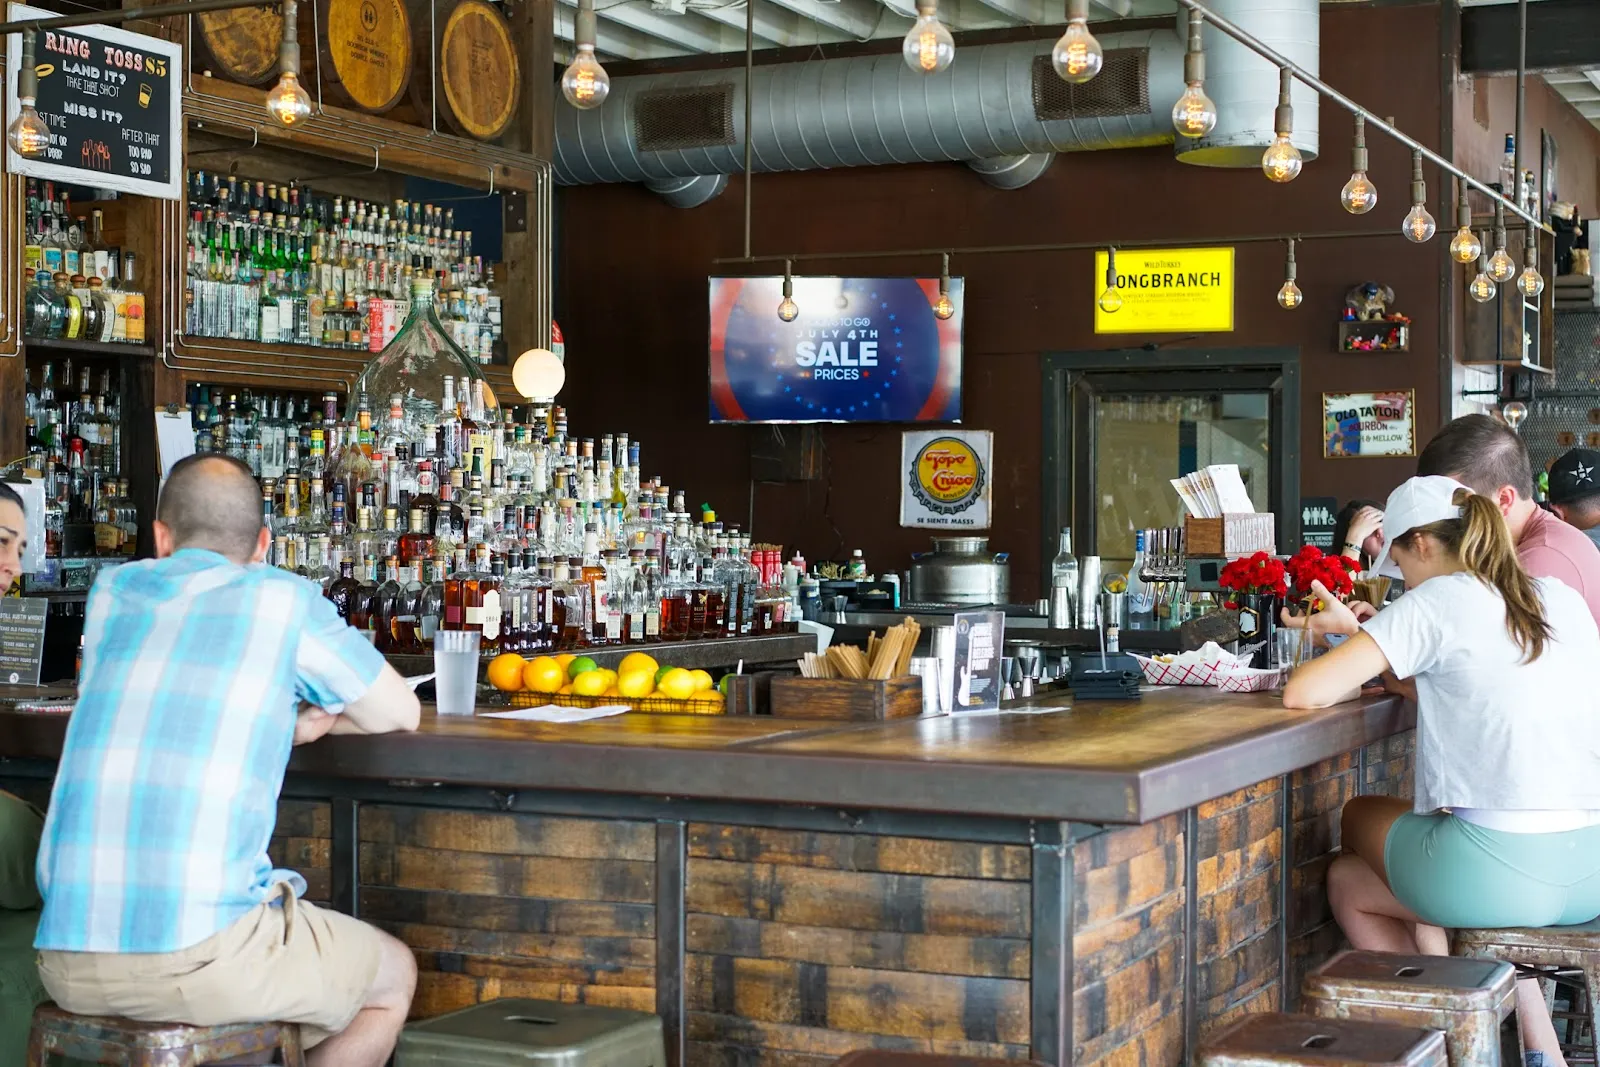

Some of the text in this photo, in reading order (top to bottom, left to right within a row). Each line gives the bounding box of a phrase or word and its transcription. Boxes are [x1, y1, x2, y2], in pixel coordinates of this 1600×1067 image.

[45, 31, 167, 77] RING TOSS $5
[62, 59, 127, 85] LAND IT?
[66, 75, 120, 98] TAKE THAT SHOT
[39, 111, 67, 129] ST TIME
[63, 101, 123, 124] MISS IT?
[59, 135, 68, 147] OR
[121, 128, 161, 147] AFTER THAT
[128, 145, 153, 160] TOO BAD
[130, 161, 152, 175] SO SAD
[1116, 272, 1221, 289] ONGBRANCH
[853, 317, 871, 327] GO
[795, 329, 878, 340] JULY 4TH
[795, 341, 878, 367] SALE
[814, 369, 859, 380] PRICES
[1335, 406, 1400, 422] OLD TAYLOR
[1348, 421, 1388, 431] BOURBON
[1373, 434, 1403, 442] MELLOW
[924, 449, 967, 470] Topo
[932, 469, 974, 491] Chico
